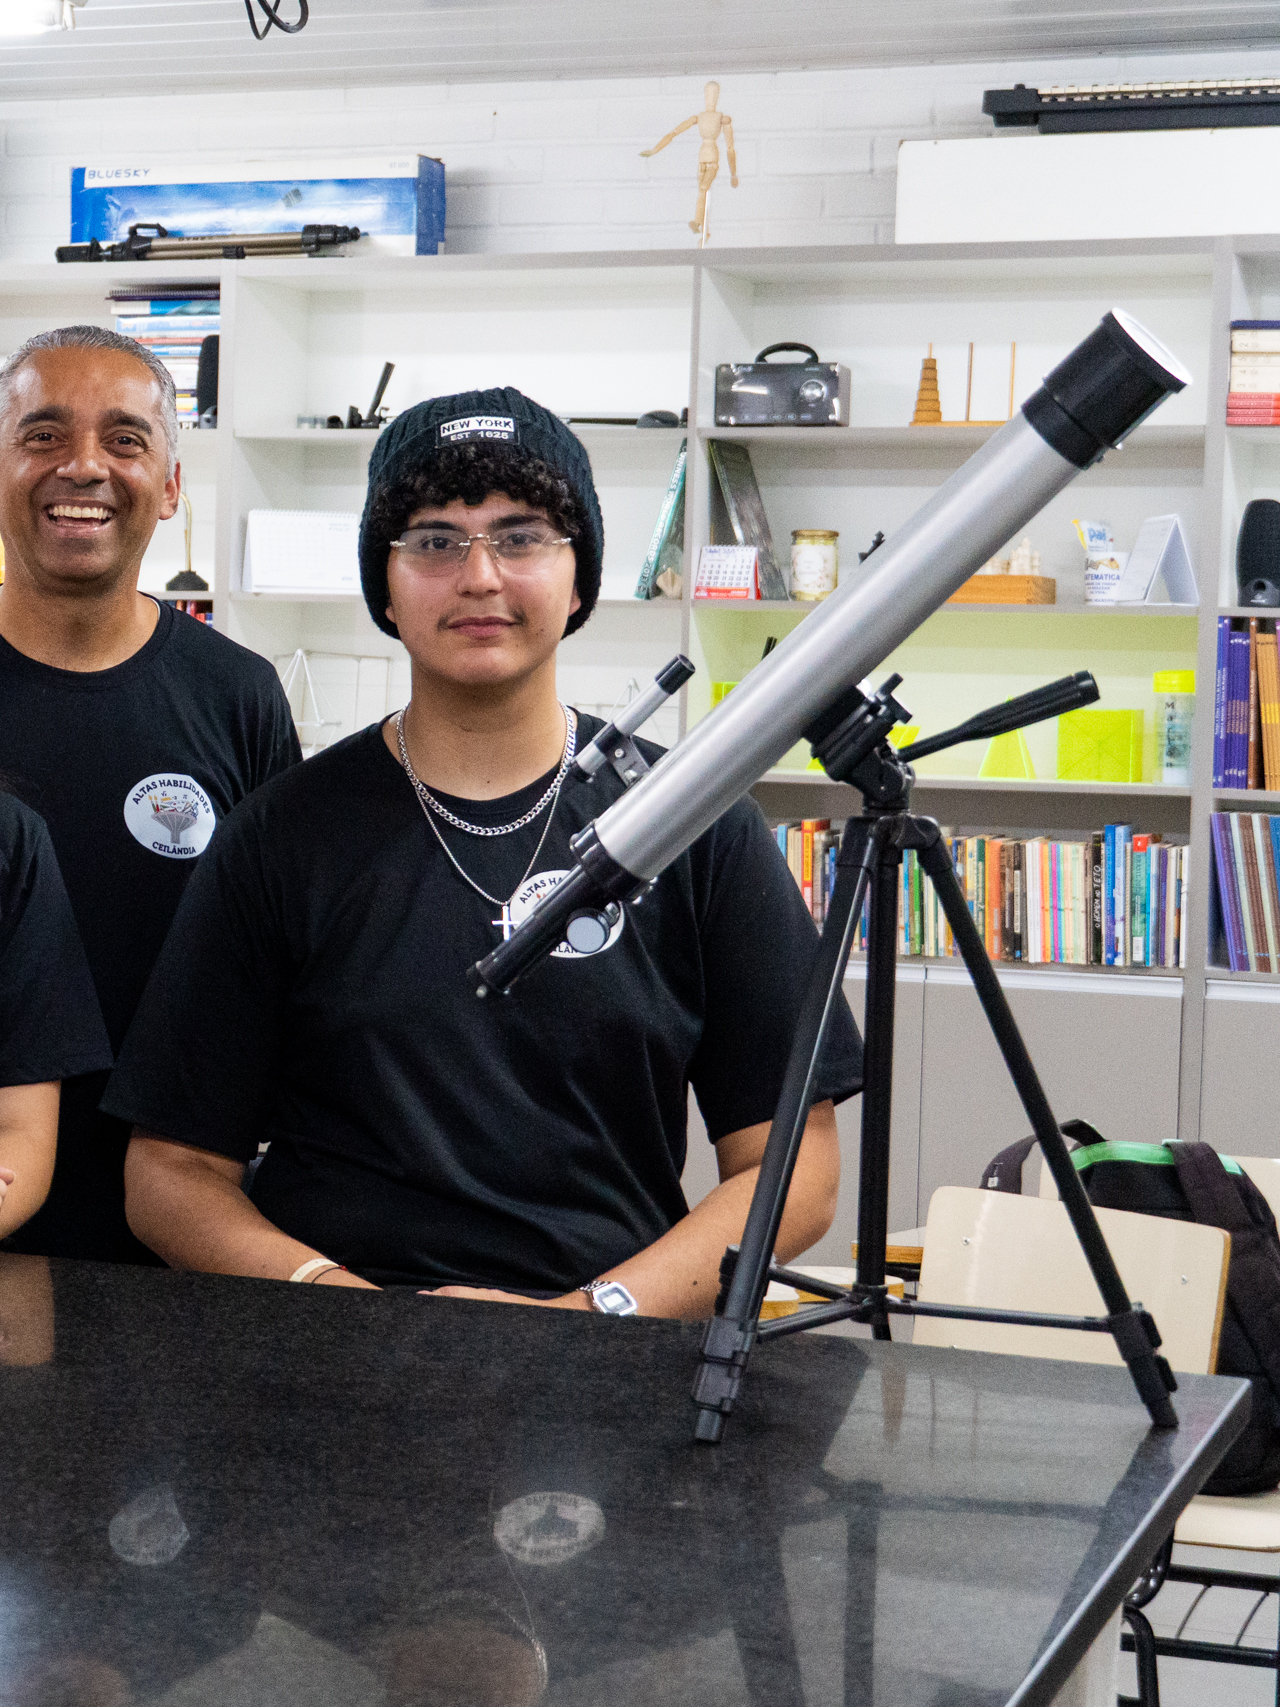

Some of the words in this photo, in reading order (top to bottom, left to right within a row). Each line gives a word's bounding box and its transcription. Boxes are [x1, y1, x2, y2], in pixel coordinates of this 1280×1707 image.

[88, 168, 150, 179] BLUESKY
[442, 420, 470, 434] NEW
[476, 419, 512, 429] YORK
[450, 431, 471, 441] EST
[477, 430, 509, 440] 1625
[648, 521, 664, 562] RECORDS
[641, 562, 652, 582] 2013
[132, 781, 157, 805] ALTAS
[158, 779, 210, 814] HABILIDADES
[152, 841, 196, 855] CEILÂNDIA
[1092, 864, 1101, 888] TETO
[519, 879, 547, 904] ALTAS
